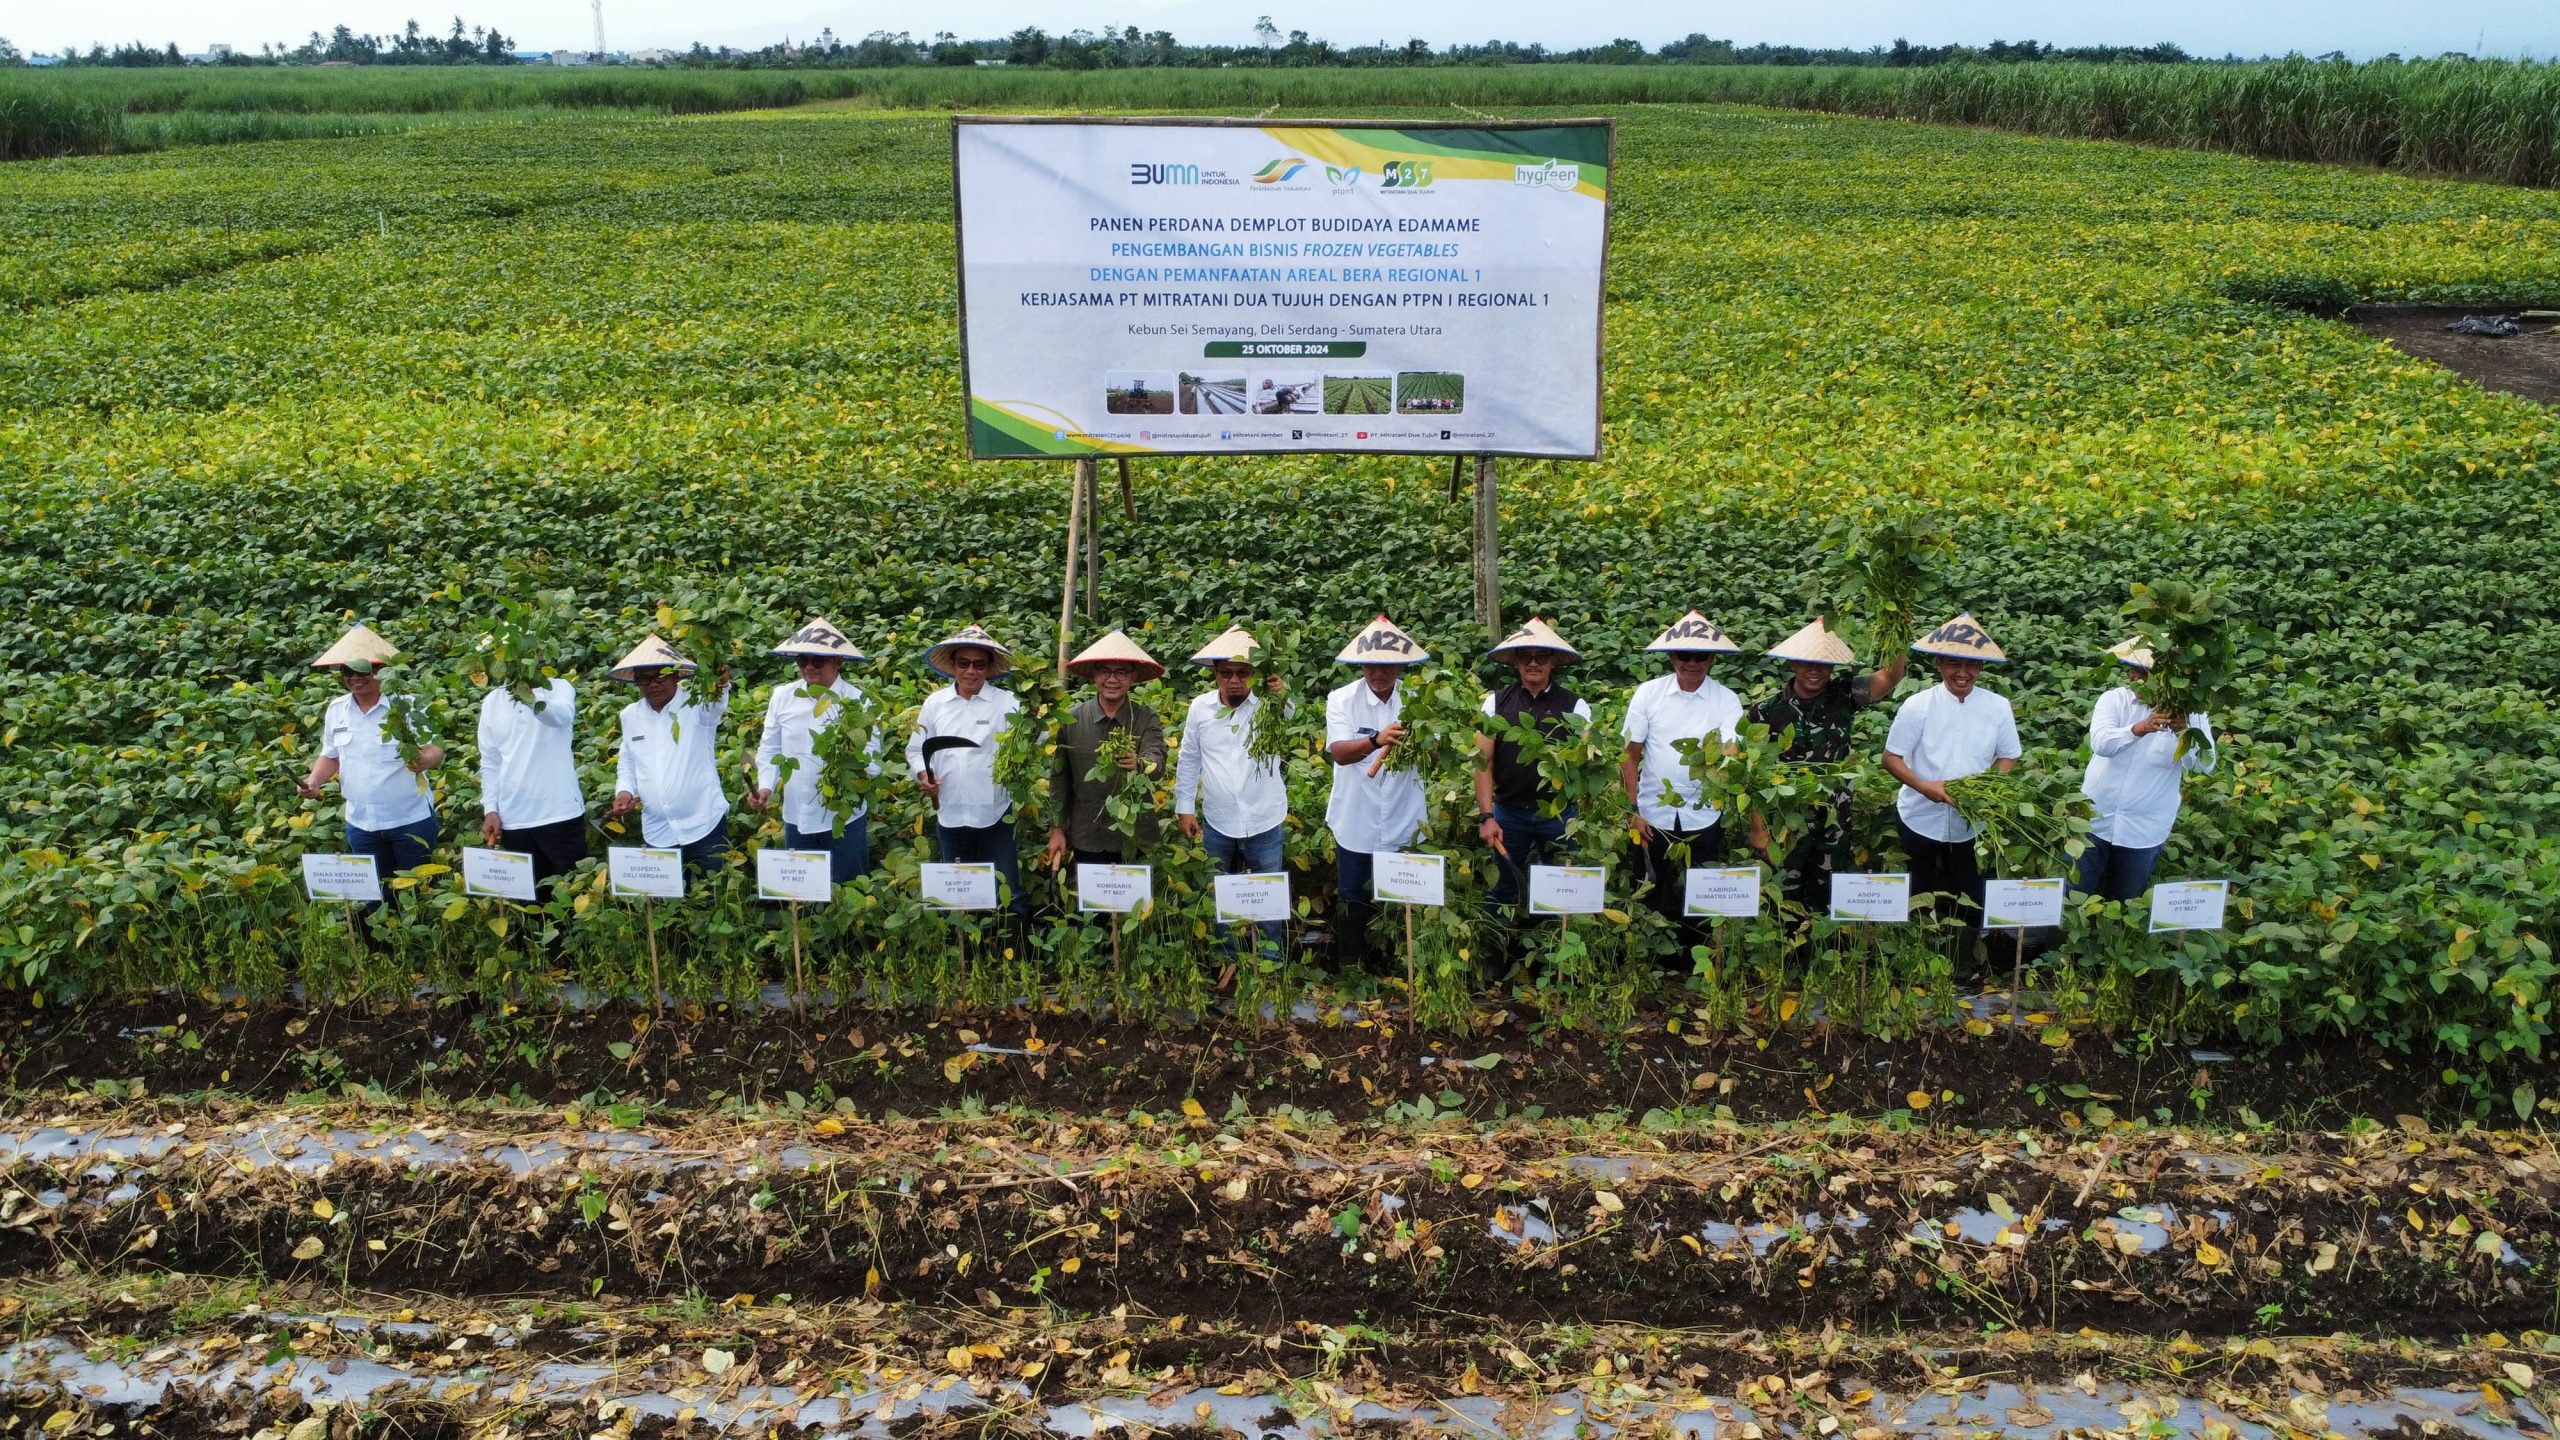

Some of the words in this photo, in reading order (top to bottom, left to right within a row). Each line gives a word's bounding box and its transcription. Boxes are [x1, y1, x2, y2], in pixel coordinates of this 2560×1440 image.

[1131, 163, 1199, 185] BUMN
[1385, 167, 1428, 181] M27
[1517, 166, 1576, 184] hygreen
[1090, 218, 1143, 231] PANEN
[1149, 218, 1225, 231] PERDANA
[1230, 218, 1306, 232] DEMPLOT
[1311, 218, 1393, 232] BUDIDAYA
[1398, 219, 1480, 232] EDAMAME
[1112, 243, 1244, 257] PENGEMBANGAN
[1249, 243, 1298, 257] BISNIS
[1303, 243, 1363, 257] FROZEN
[1368, 243, 1459, 257] VEGETABLES
[1090, 268, 1158, 281] DENGAN
[1164, 268, 1281, 282] PEMANFAATAN
[1286, 268, 1338, 282] AREAL
[1342, 268, 1383, 282] BERA
[1388, 268, 1469, 282] REGIONAL
[1474, 269, 1481, 282] 1
[1021, 293, 1114, 306] KERJASAMA
[1119, 293, 1138, 306] PT
[1143, 293, 1229, 307] MITRATANI
[1234, 293, 1267, 306] DUA
[1272, 293, 1324, 307] TUJUH
[1329, 293, 1397, 307] DENGAN
[1402, 293, 1443, 307] PTPN
[1448, 294, 1453, 307] I
[1458, 293, 1537, 306] REGIONAL
[1542, 293, 1549, 306] 1
[1128, 325, 1167, 335] Kebun
[1170, 325, 1188, 335] Sei
[1192, 325, 1257, 338] Semayang,
[1261, 325, 1285, 335] Deli
[1288, 324, 1338, 338] Serdang
[1349, 325, 1406, 336] Sumatera
[1410, 325, 1442, 335] Utara
[1242, 344, 1254, 354] 25
[1256, 344, 1302, 354] OKTOBER
[1304, 344, 1329, 354] 2024
[787, 627, 847, 649] M27
[1665, 620, 1722, 642] M27
[1928, 623, 1991, 649] M27
[1357, 630, 1414, 655] M27
